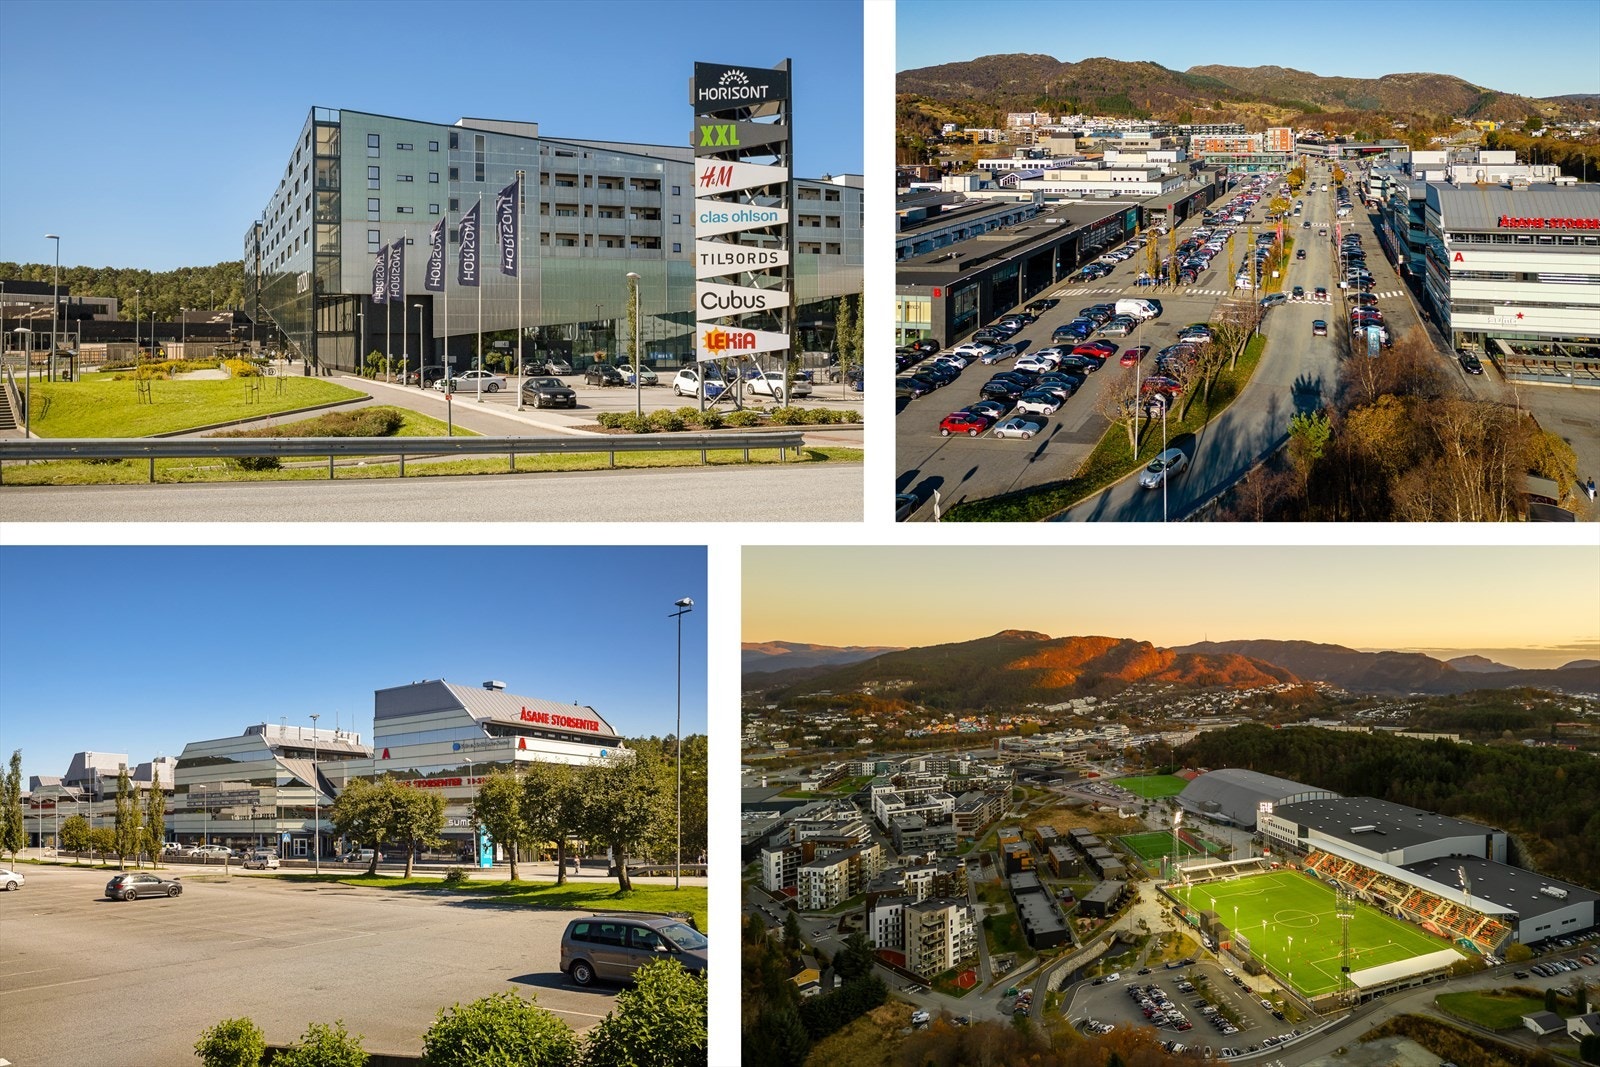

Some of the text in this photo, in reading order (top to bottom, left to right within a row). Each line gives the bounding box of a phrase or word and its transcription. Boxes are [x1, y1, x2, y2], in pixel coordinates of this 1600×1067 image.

[699, 85, 769, 101] HORISONT
[700, 124, 740, 146] XXL
[700, 165, 734, 188] H&M
[700, 210, 778, 223] clas ohlson
[1500, 214, 1545, 229] ÅSANE
[701, 252, 778, 265] TILBORDS
[1454, 252, 1464, 262] A
[700, 290, 766, 310] Cubus
[520, 706, 600, 732] ÅSANE STORSENTER
[518, 737, 527, 751] A
[382, 747, 391, 760] A
